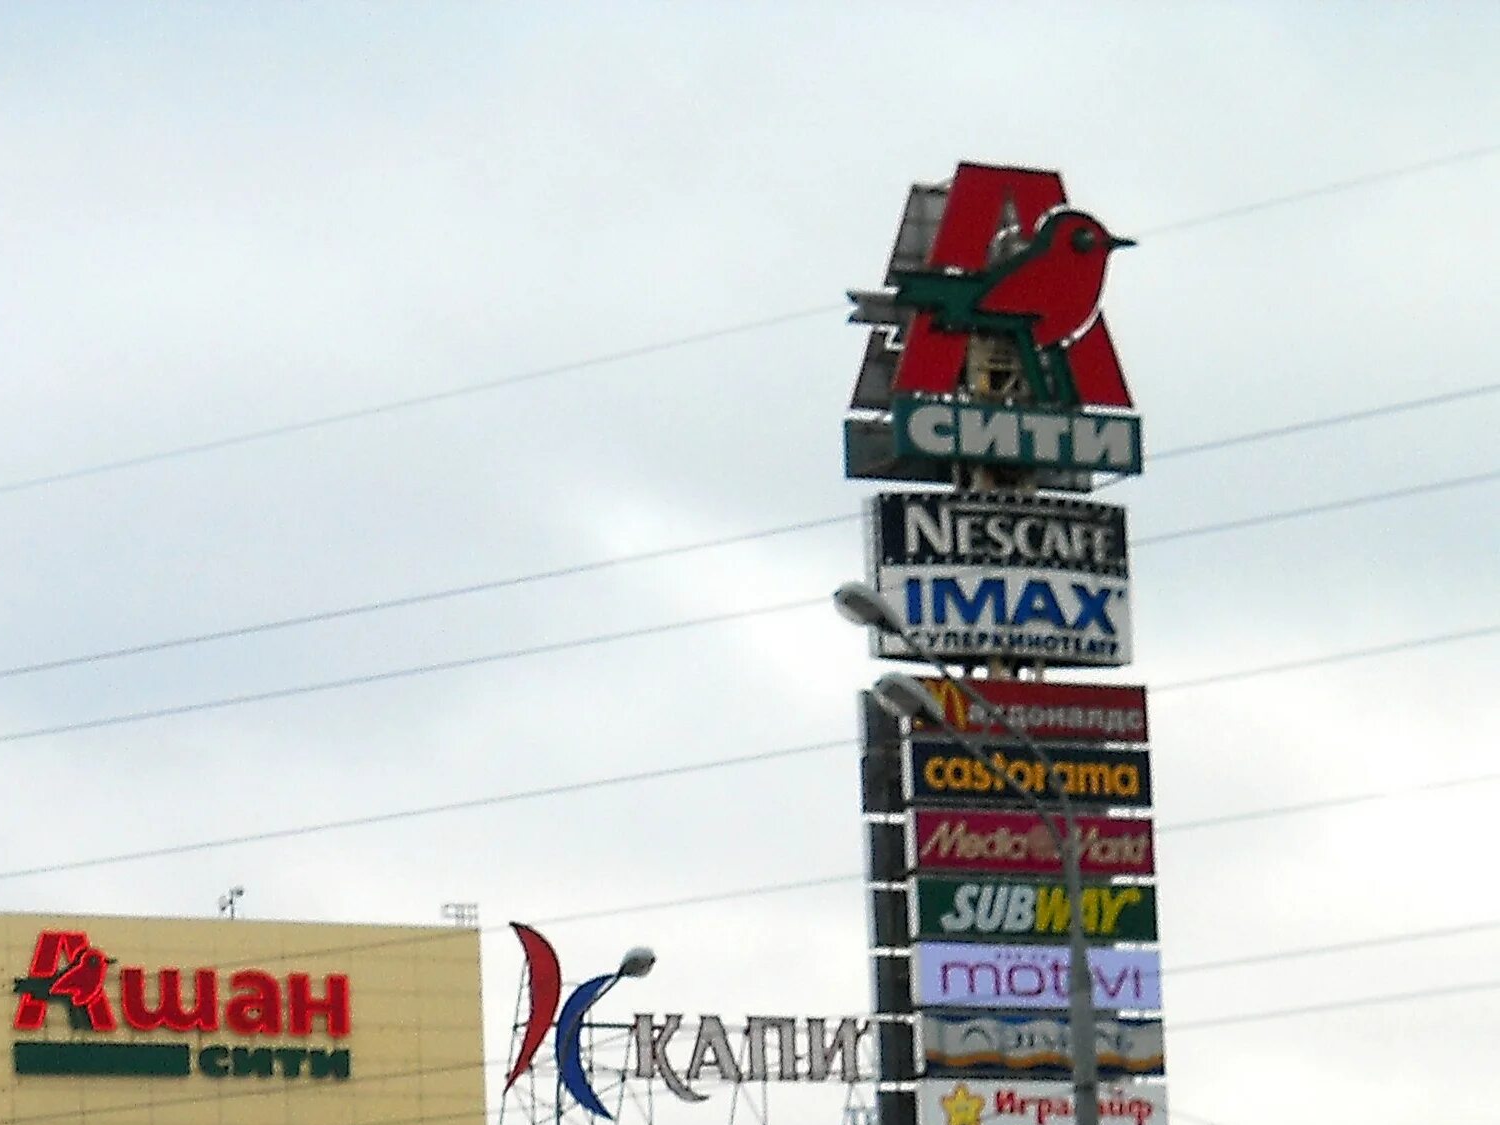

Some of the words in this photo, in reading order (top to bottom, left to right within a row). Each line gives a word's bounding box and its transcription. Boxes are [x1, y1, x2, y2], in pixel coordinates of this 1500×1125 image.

[908, 406, 1132, 465] СИТИ
[906, 577, 1115, 634] IMAX
[201, 1045, 351, 1079] СИТИ
